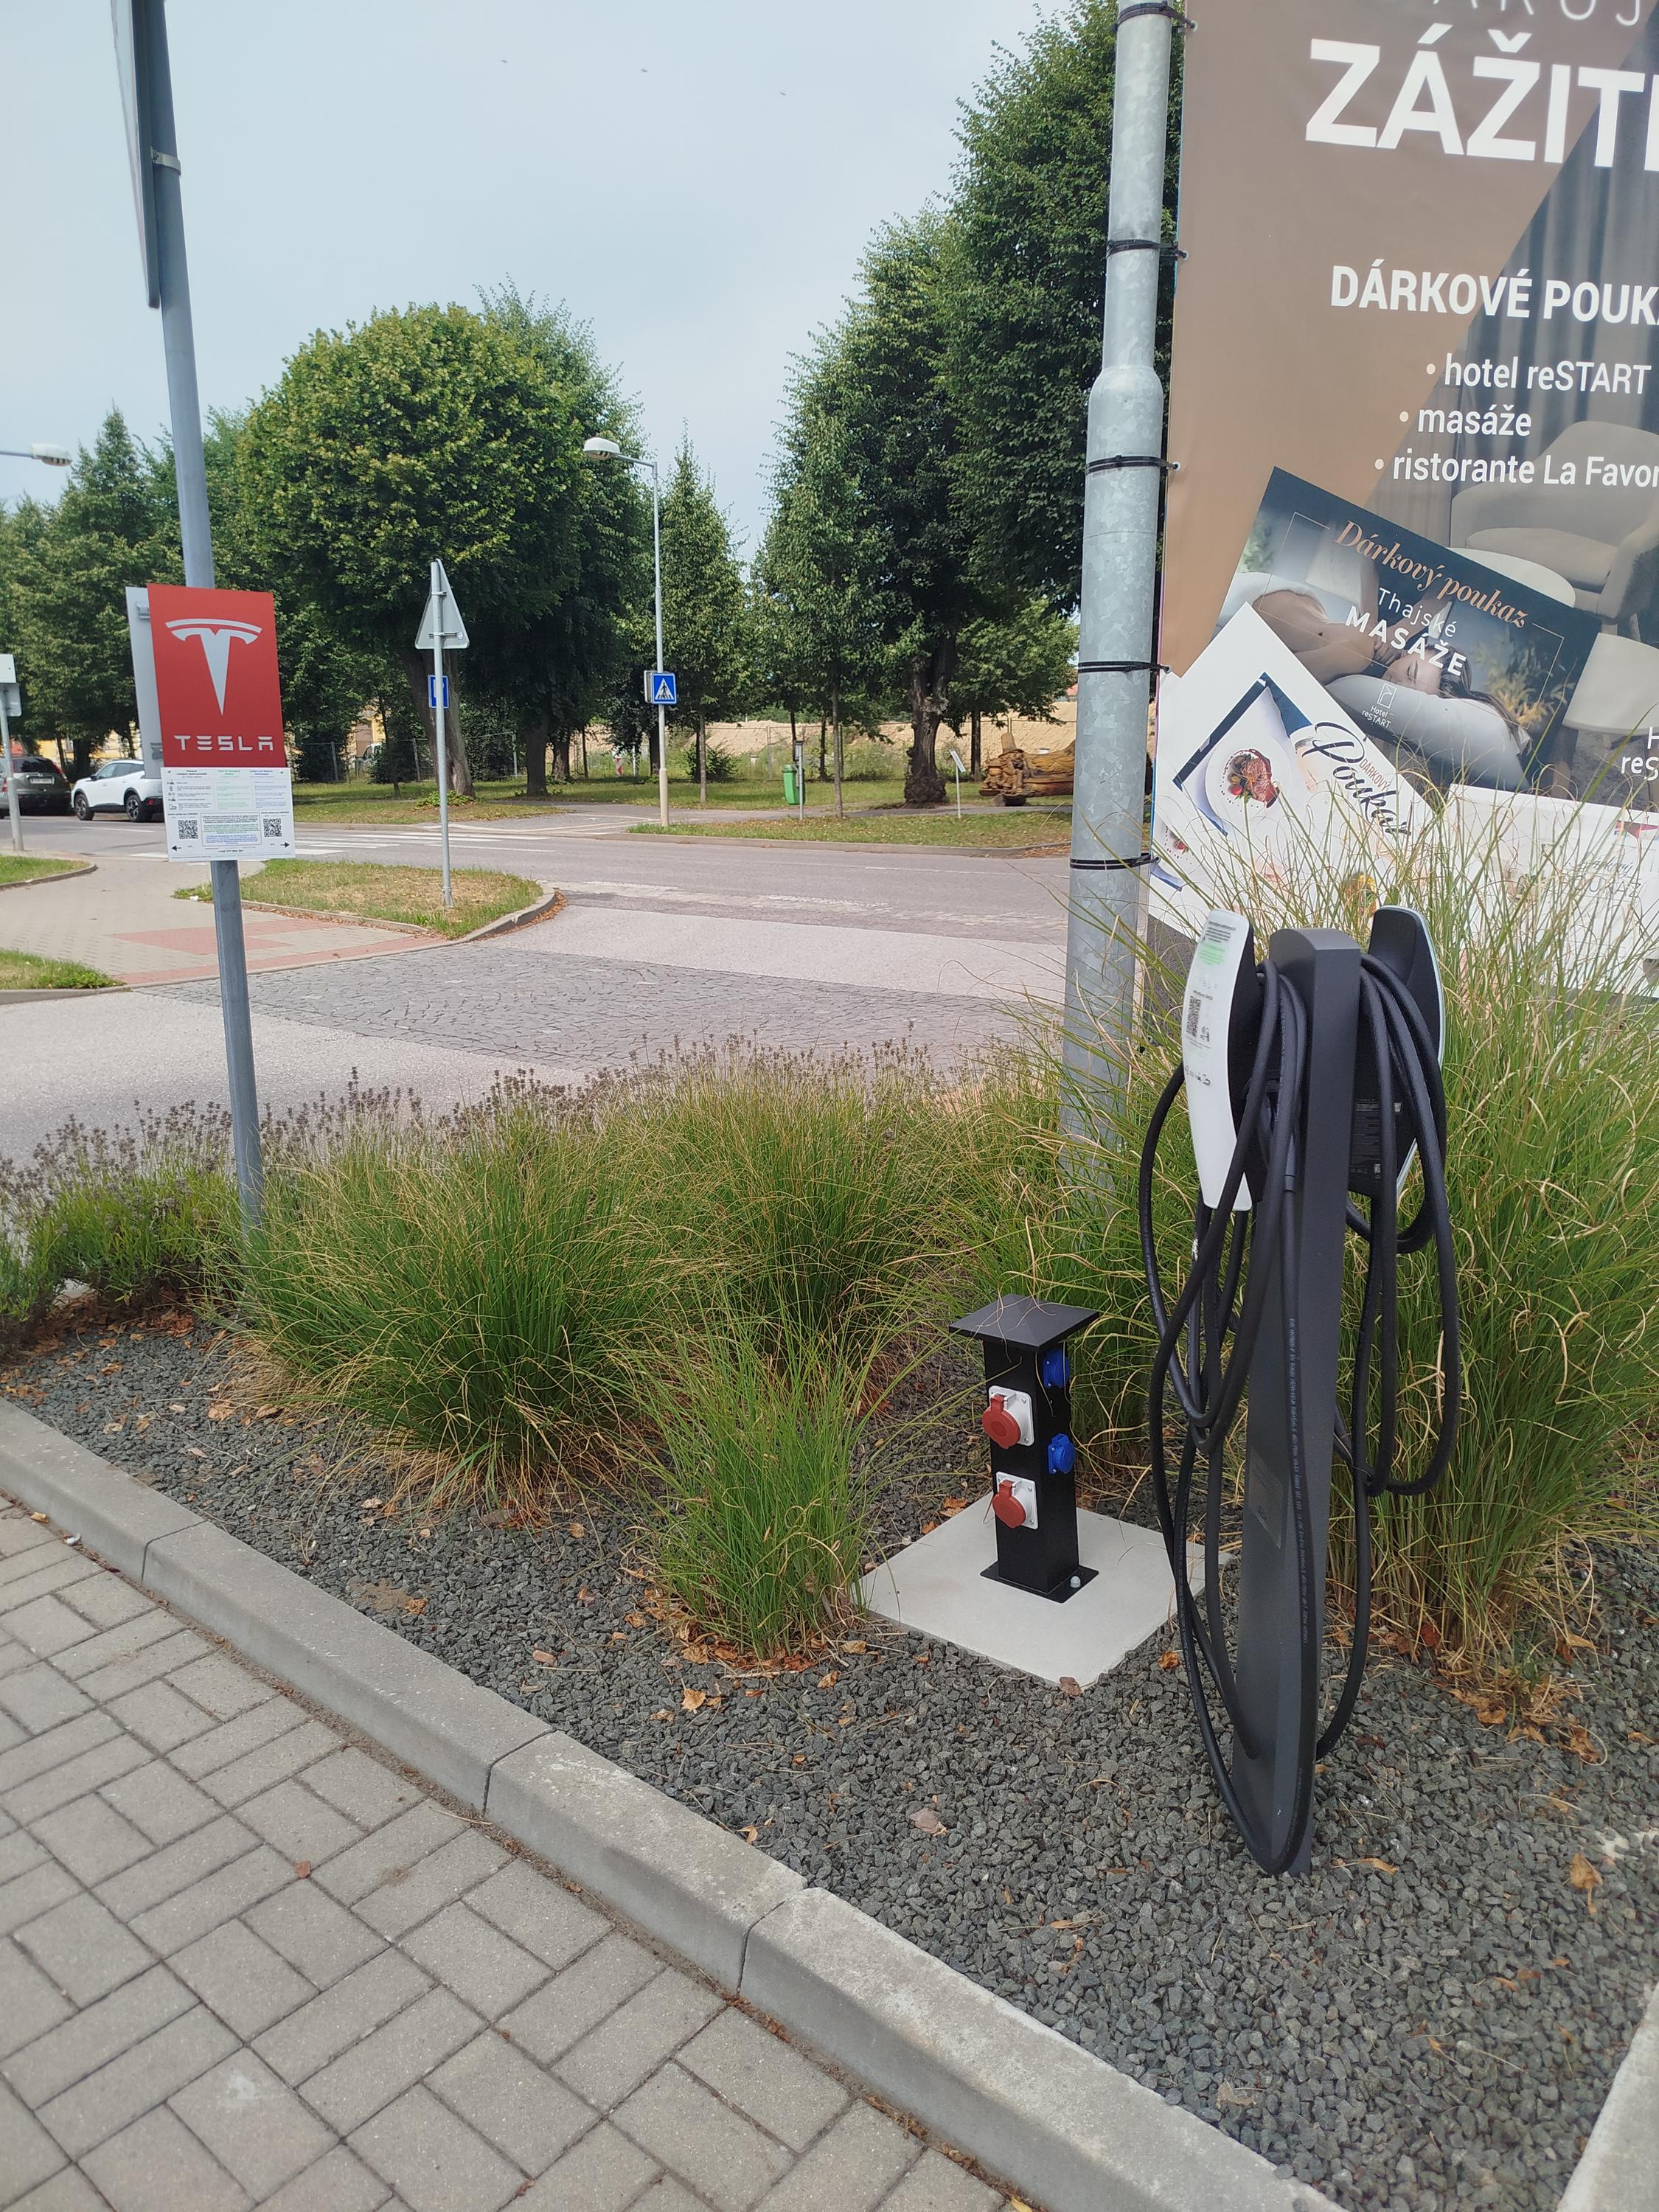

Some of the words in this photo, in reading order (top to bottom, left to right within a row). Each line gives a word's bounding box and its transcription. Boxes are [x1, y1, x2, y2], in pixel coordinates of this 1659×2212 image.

[1305, 23, 1659, 172] ZÁŽIT
[1330, 259, 1532, 318] DÁRKOVÉ
[1543, 279, 1659, 325] POUK
[1444, 353, 1518, 389] hotel
[1527, 361, 1652, 394] reSTART
[1417, 404, 1531, 437] masáže
[1393, 448, 1534, 483] ristorante
[1544, 454, 1576, 485] La
[1334, 519, 1445, 591] Dárkový
[1436, 577, 1528, 628] poukaz
[1377, 587, 1458, 638] Thajské
[1345, 605, 1467, 676] MASÁŽE
[1361, 710, 1391, 728] reSTART
[1370, 705, 1388, 717] Hotel
[174, 734, 274, 751] TESLA
[1359, 758, 1391, 791] DÁRKOVÝ
